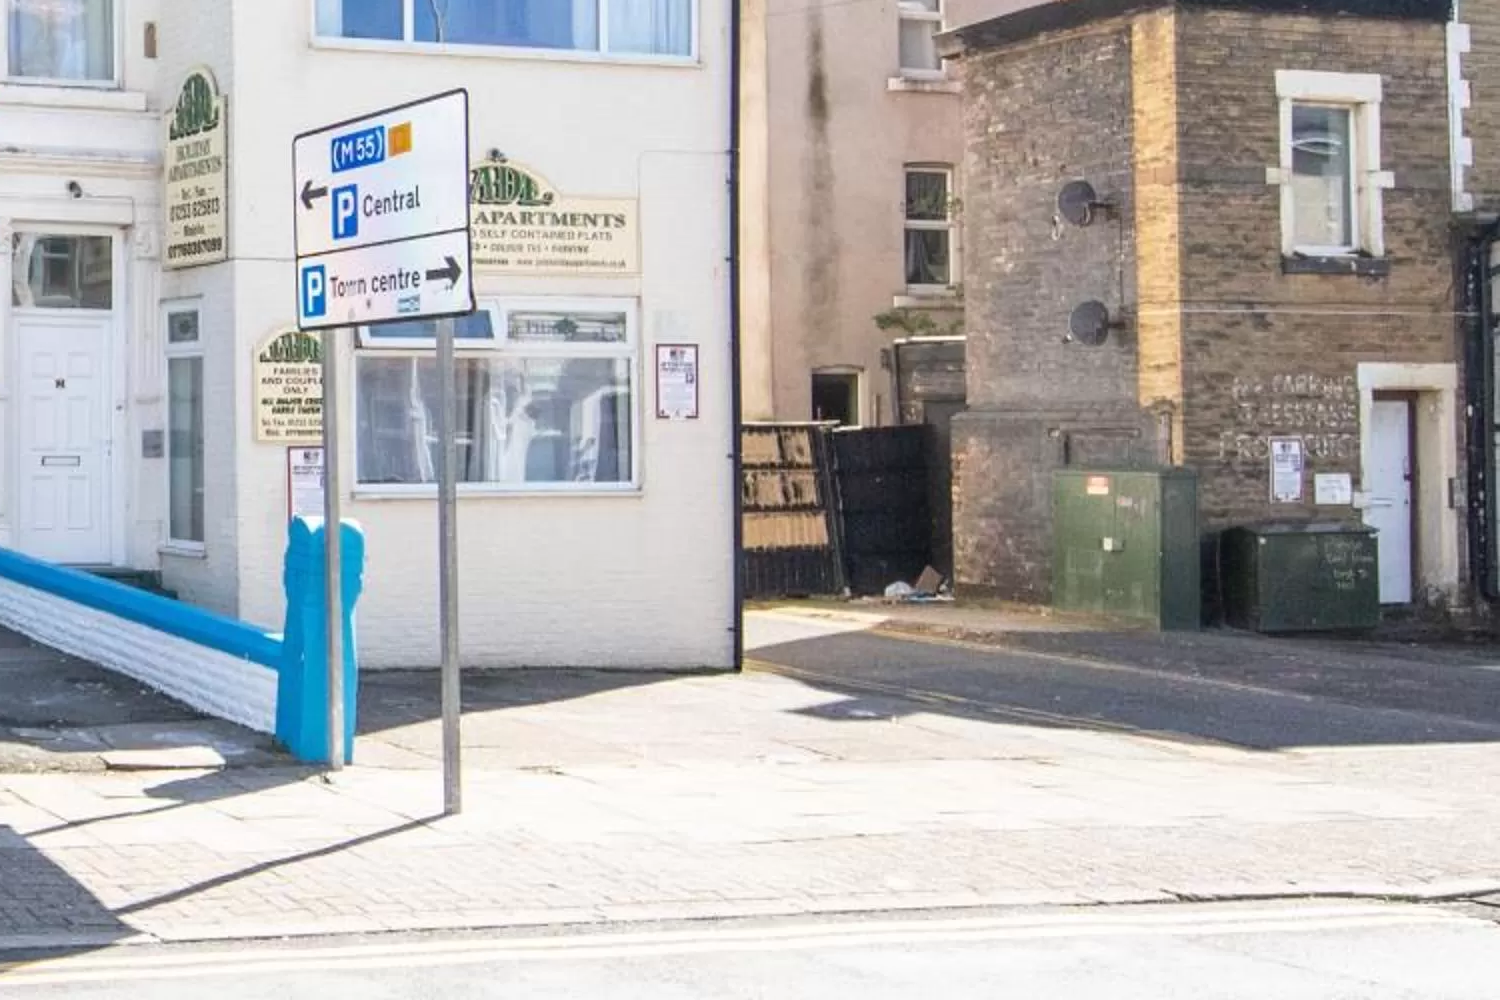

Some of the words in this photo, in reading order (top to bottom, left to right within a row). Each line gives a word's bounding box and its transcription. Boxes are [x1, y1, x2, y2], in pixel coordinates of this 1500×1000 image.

[336, 190, 356, 236] P
[362, 184, 421, 218] Central
[474, 210, 627, 229] APARTMENTS
[479, 228, 508, 238] SELF
[511, 228, 576, 241] CONTAINED
[577, 230, 613, 242] FLATS
[306, 270, 324, 313] P
[371, 270, 421, 292] centre
[261, 377, 282, 385] AND
[283, 386, 309, 394] ONLY
